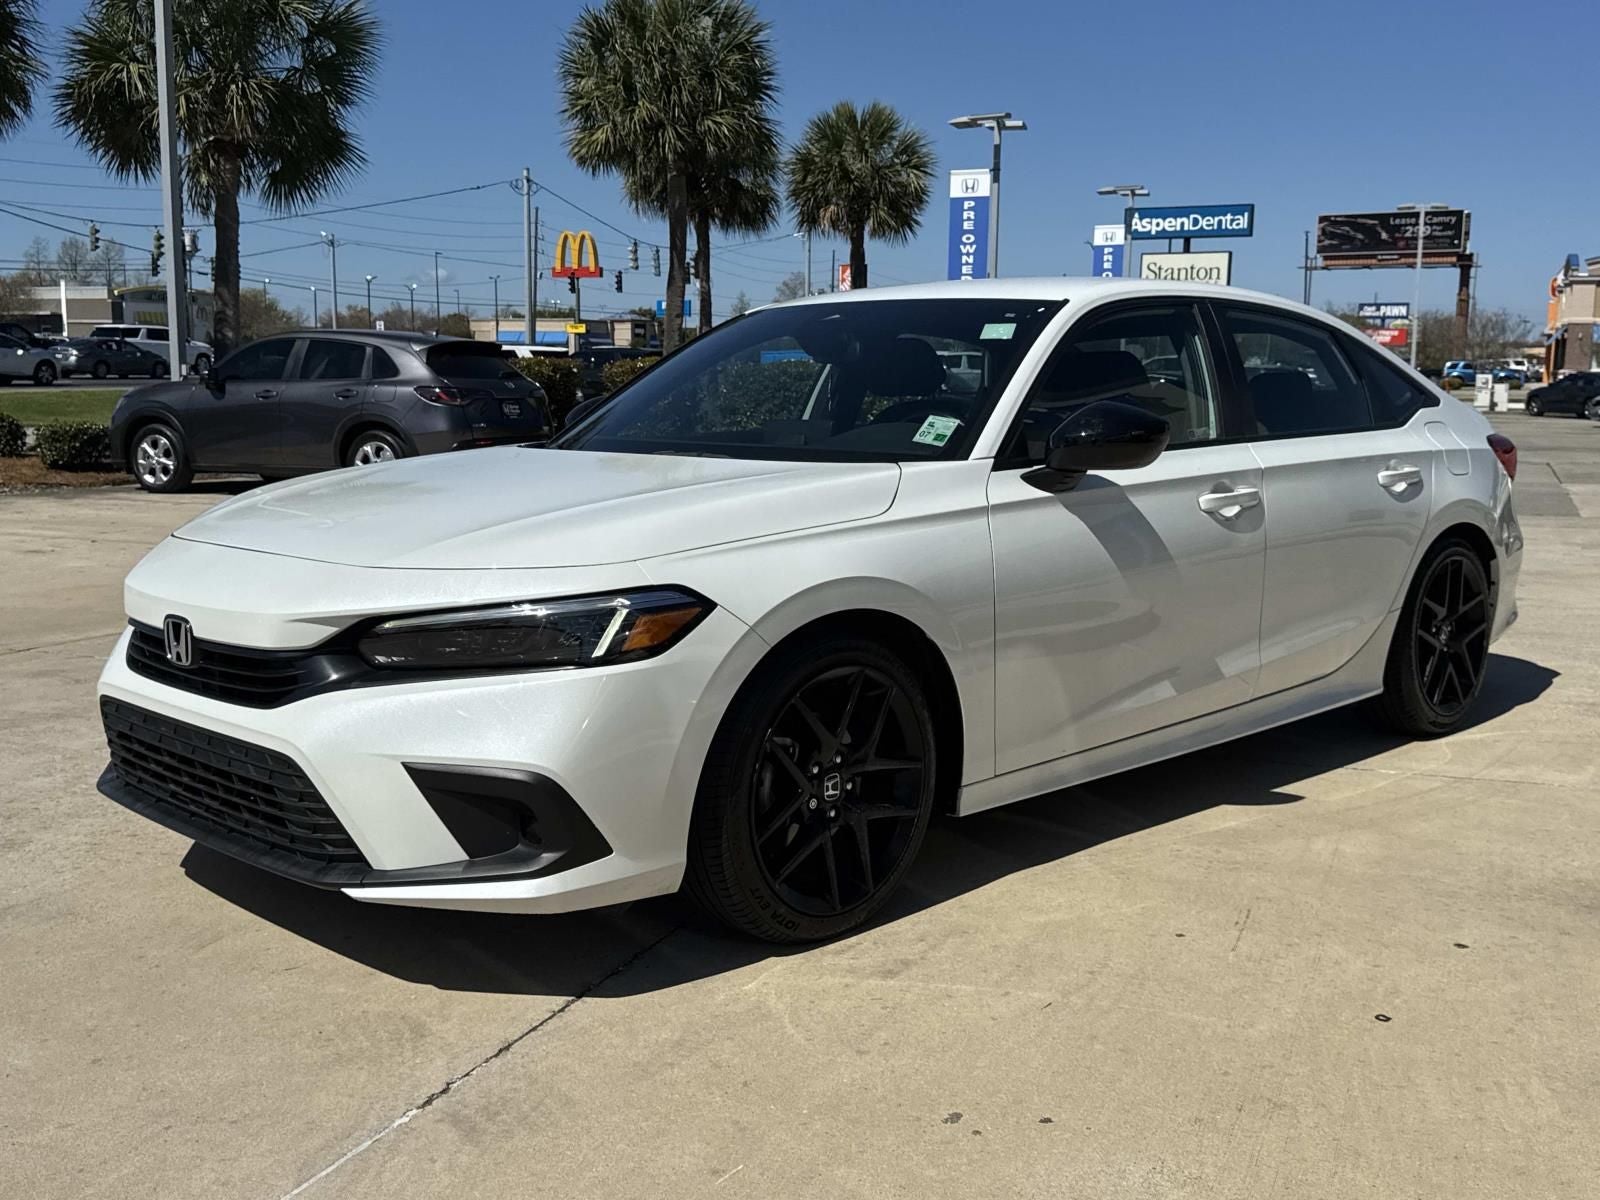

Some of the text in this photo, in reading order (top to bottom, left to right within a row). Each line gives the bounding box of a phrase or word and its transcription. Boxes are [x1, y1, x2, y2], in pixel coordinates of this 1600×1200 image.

[963, 200, 976, 230] PRE
[1390, 216, 1416, 225] Lease
[1425, 215, 1457, 225] Camry
[1146, 262, 1221, 281] Stanton
[1380, 305, 1407, 317] PAWN
